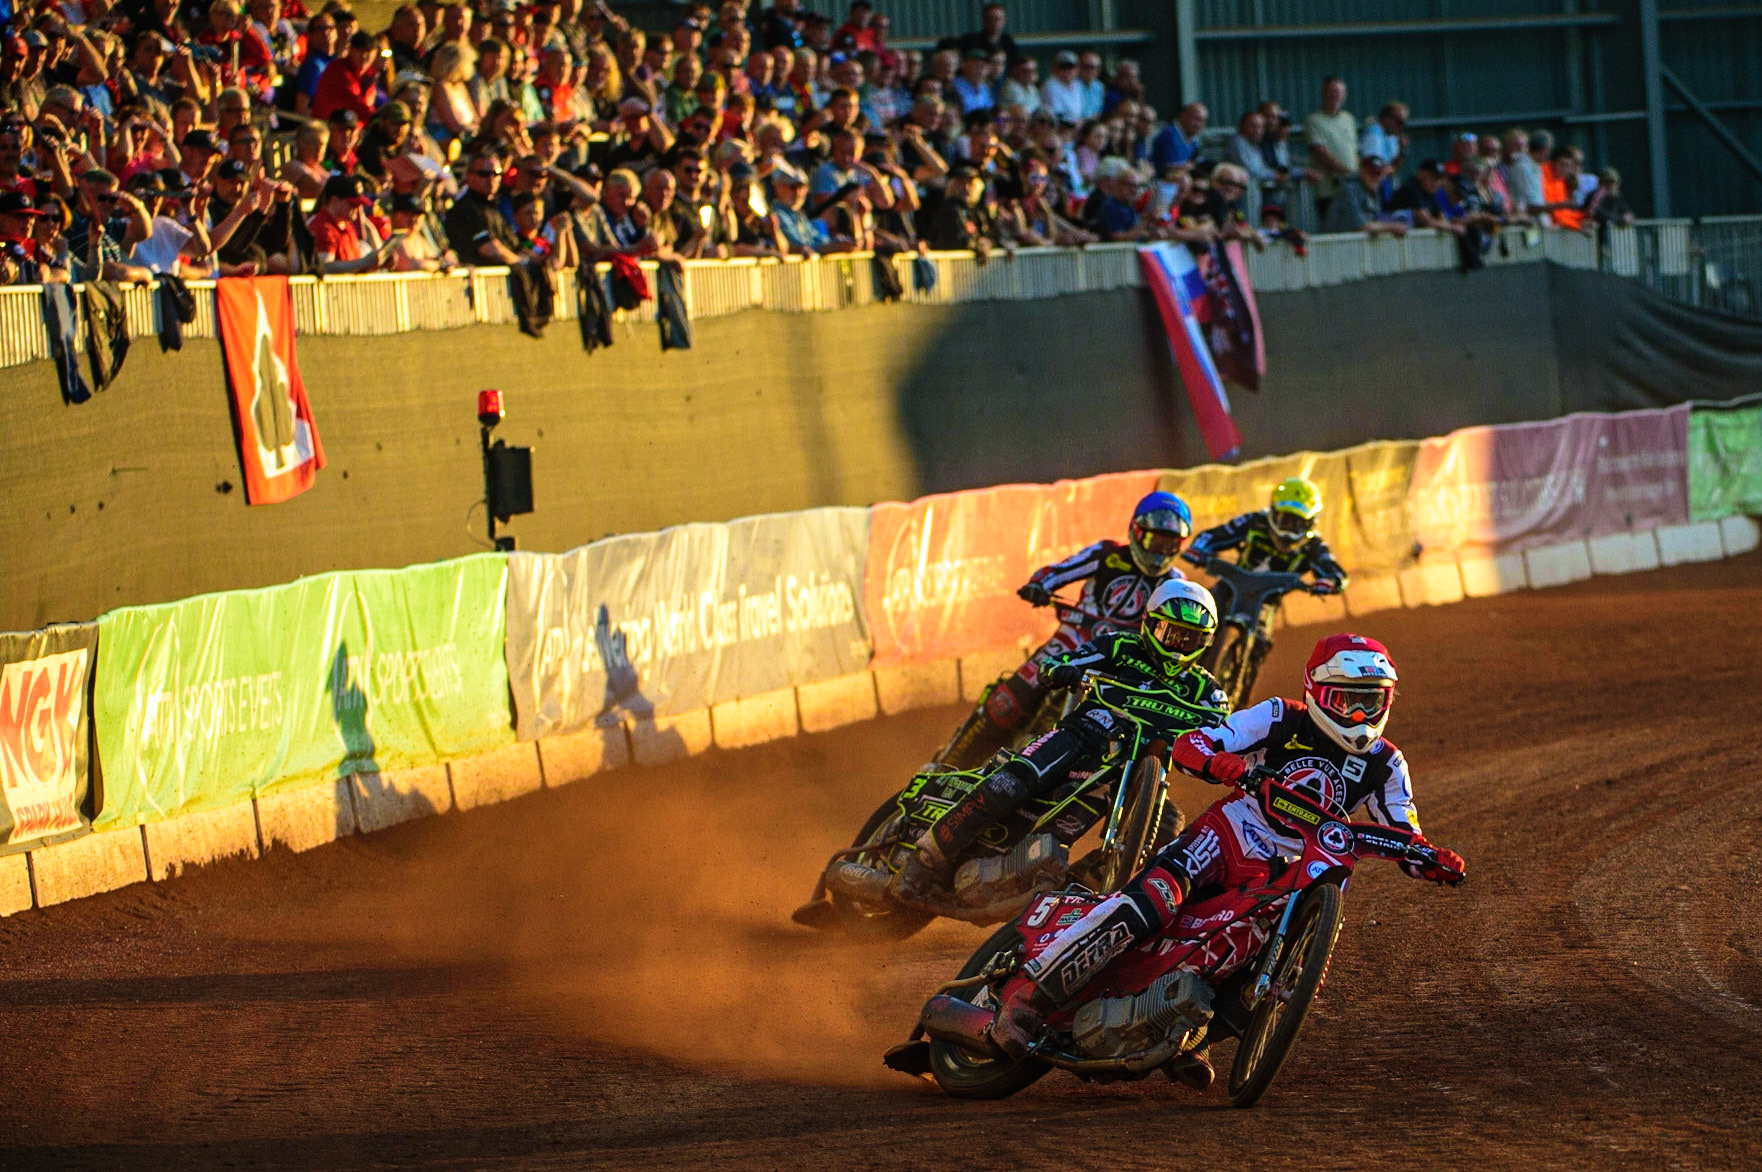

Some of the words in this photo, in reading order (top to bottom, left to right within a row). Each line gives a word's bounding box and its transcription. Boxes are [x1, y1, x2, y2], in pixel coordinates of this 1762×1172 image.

[0, 658, 84, 790] NGK
[1132, 697, 1164, 711] TRU
[1165, 705, 1198, 722] MIX
[1284, 759, 1314, 775] BELLE
[1319, 760, 1335, 777] VUE
[1333, 778, 1343, 803] ACES
[922, 804, 948, 819] TR
[1027, 896, 1055, 927] 5
